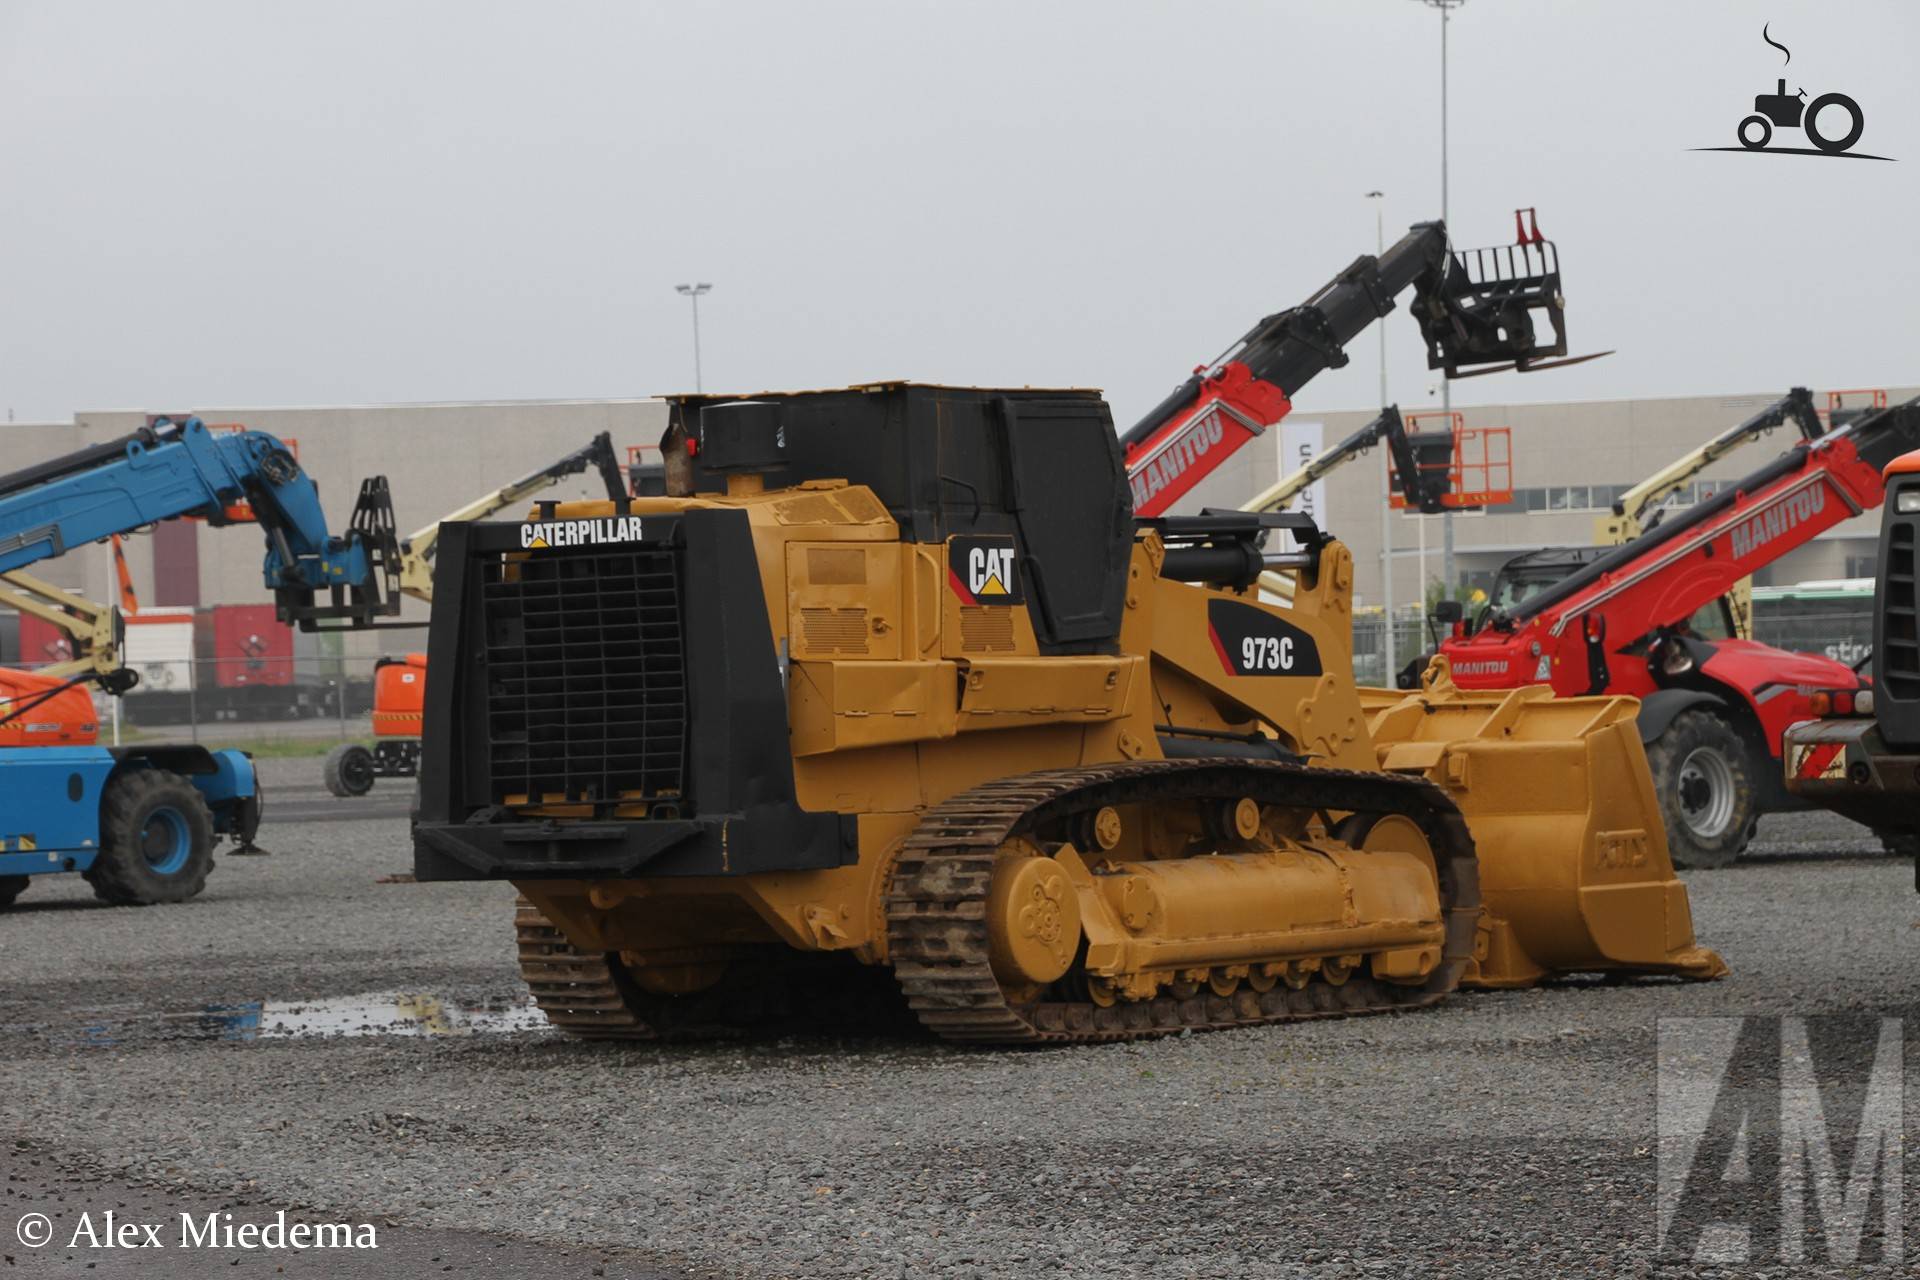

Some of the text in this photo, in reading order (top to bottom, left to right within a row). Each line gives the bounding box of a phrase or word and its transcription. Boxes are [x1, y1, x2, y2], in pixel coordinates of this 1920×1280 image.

[521, 517, 642, 548] CATERPILLAR
[1731, 480, 1825, 560] MANITOU
[969, 547, 1015, 594] CAT
[1242, 637, 1294, 670] 973C
[1453, 661, 1508, 674] MANITOU
